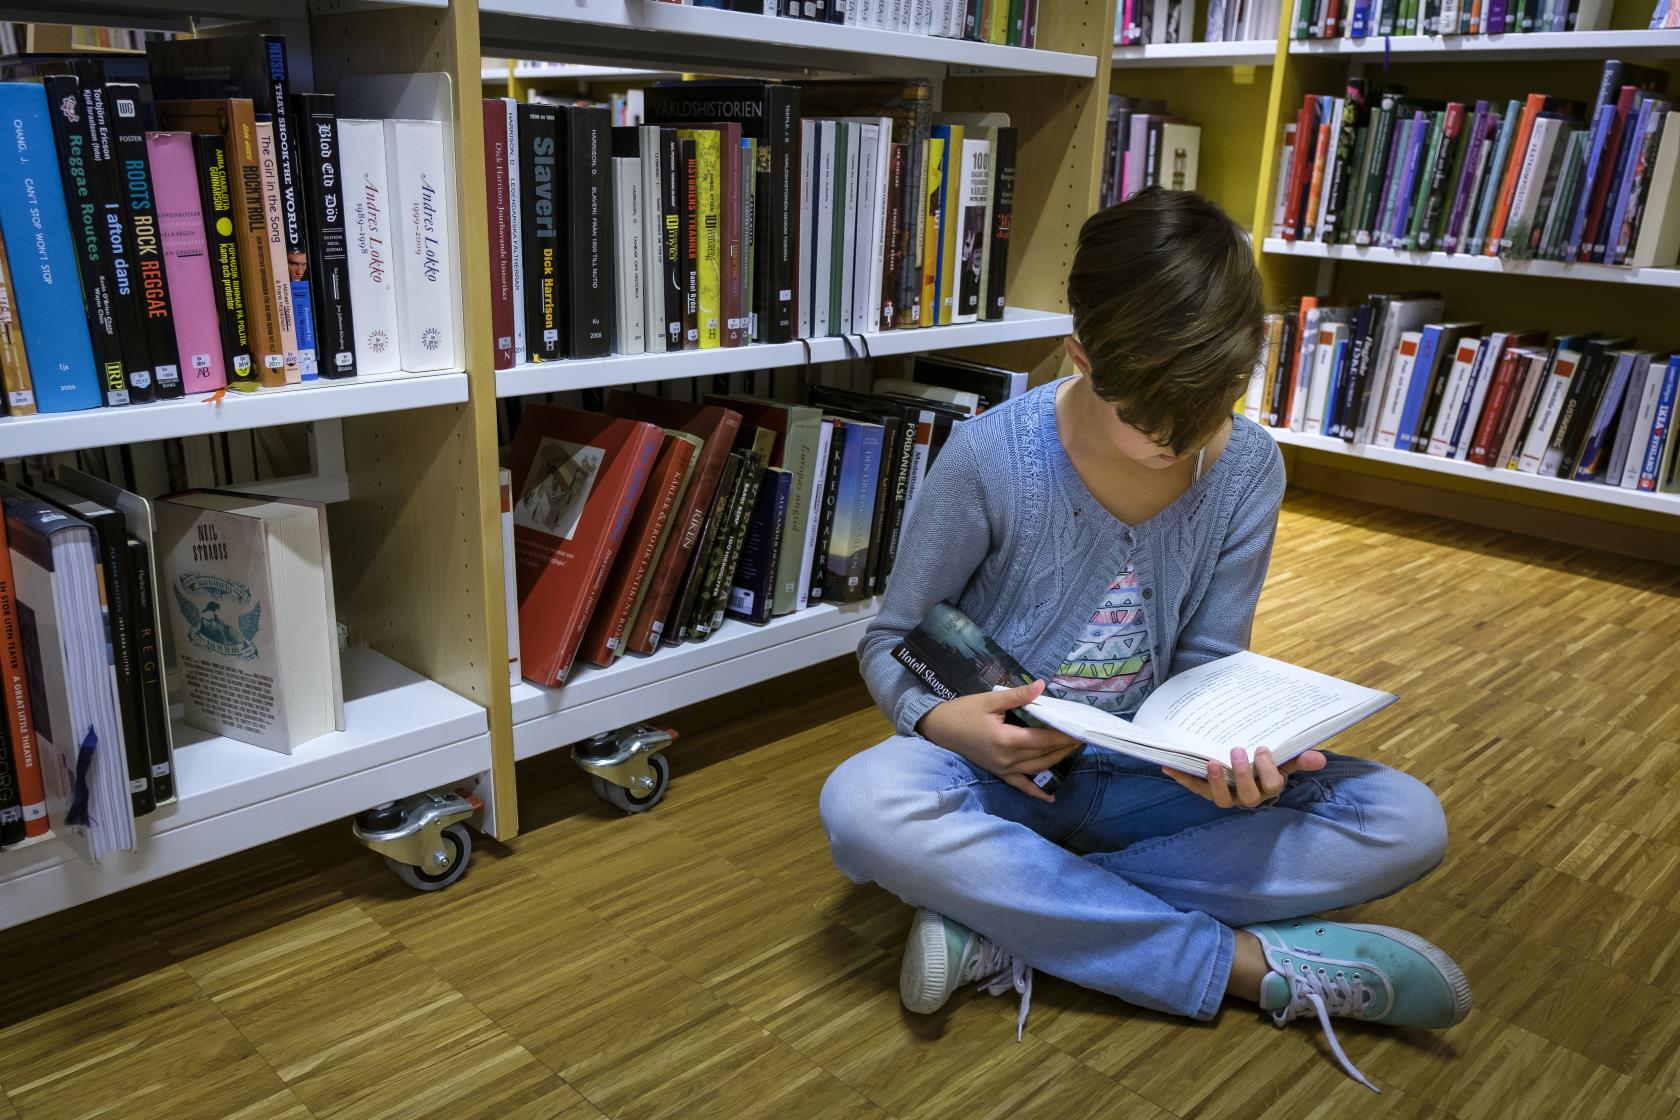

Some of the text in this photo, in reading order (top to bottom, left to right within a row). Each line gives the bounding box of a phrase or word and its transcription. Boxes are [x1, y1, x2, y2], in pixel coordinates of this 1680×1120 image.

[275, 83, 285, 116] THAT
[13, 119, 28, 153] CHANG,
[84, 89, 102, 162] Kjell Israelsson (foto)
[92, 88, 111, 161] Torbjörn Ericson
[278, 117, 290, 160] SHOOK
[316, 123, 333, 158] Blod
[209, 166, 223, 211] GUNNARSON
[215, 149, 230, 211] ANNA CHARLOTTA
[261, 135, 281, 243] The Girl in the Song
[283, 161, 292, 185] THE
[322, 162, 335, 187] Eld
[496, 170, 505, 206] Harrison
[533, 136, 557, 238] Slaveri
[69, 135, 99, 261] Reggae Routes
[285, 187, 299, 244] WORLD
[325, 193, 339, 223] Död
[688, 159, 697, 260] HISTORIENS TYRANNER
[24, 178, 54, 285] CAN'T STOP WON'T STOP
[107, 213, 124, 255] afton
[125, 160, 168, 319] ROOTS ROCK REGGAE
[364, 172, 385, 283] Andres Lokko
[420, 173, 440, 282] Andres Lokko
[497, 206, 506, 259] Jourhavande
[510, 178, 520, 292] LEGENDARISKA FÄLTHERRAR
[705, 214, 717, 229] 101
[665, 229, 678, 262] myter
[704, 230, 716, 262] misstag
[114, 258, 130, 296] dans
[219, 243, 235, 310] Kamp och protester
[228, 243, 248, 346] POPMUSIK RIMMAR PÅ POLITIK
[500, 260, 508, 301] historiker
[543, 248, 555, 329] Dick Harrison
[278, 301, 287, 332] Hopkinson
[109, 364, 124, 390] IRP
[1551, 396, 1577, 449] GUSTAVSBERG
[1653, 403, 1669, 430] IKEA
[894, 420, 918, 502] FÖRBANNELSE
[659, 471, 684, 511] KÄRLEK
[738, 482, 750, 505] BARRY
[790, 443, 810, 533] Europas ungtid
[197, 523, 219, 542] NEIL
[656, 510, 668, 524] &
[681, 507, 704, 550] RIKEN
[732, 505, 743, 525] KEMP
[191, 543, 230, 561] STRAUSS
[0, 594, 12, 616] STOR
[618, 565, 647, 616] ANTIKENS
[4, 617, 15, 641] LITEN
[8, 641, 19, 670] TEATER
[897, 647, 958, 702] Hotell Skuggsi
[13, 675, 33, 768] A GREAT LITTLE THEATRE
